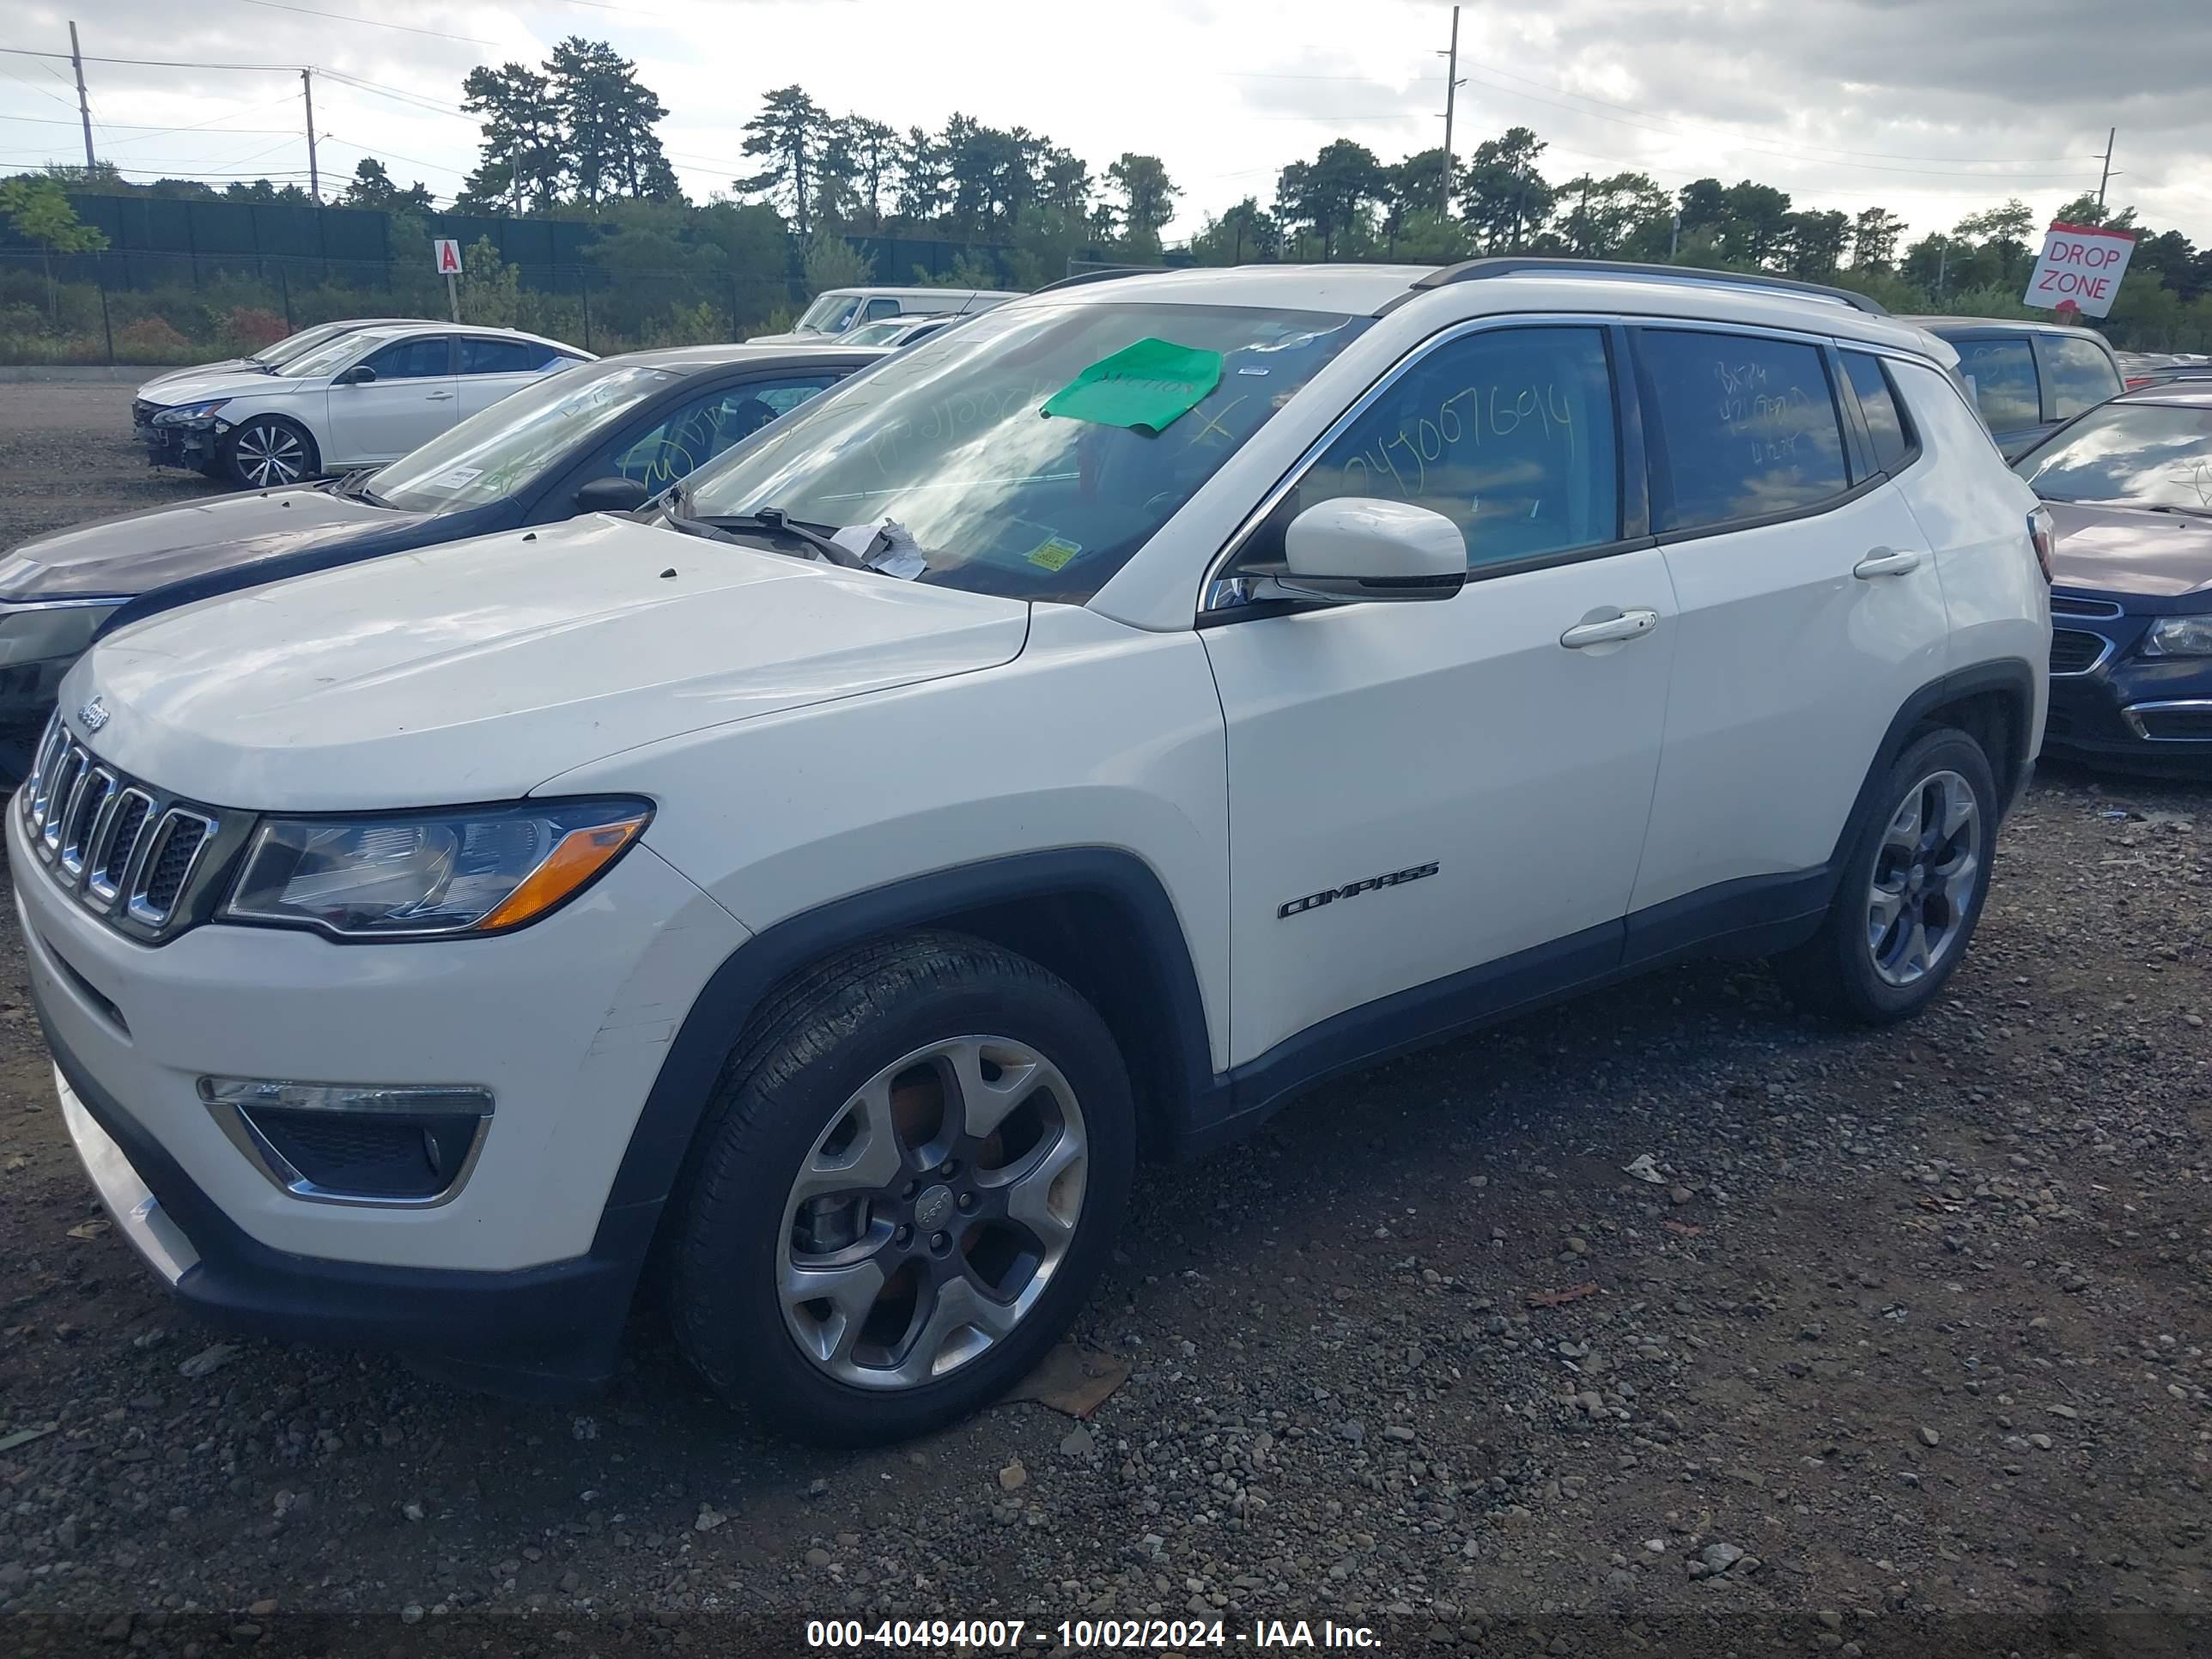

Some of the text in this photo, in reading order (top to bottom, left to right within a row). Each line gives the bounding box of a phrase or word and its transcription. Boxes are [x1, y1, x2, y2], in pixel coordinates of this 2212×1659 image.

[442, 240, 458, 270] A
[2049, 241, 2120, 270] DROP
[2039, 269, 2111, 300] ZONE
[1277, 860, 1440, 919] COMPASS
